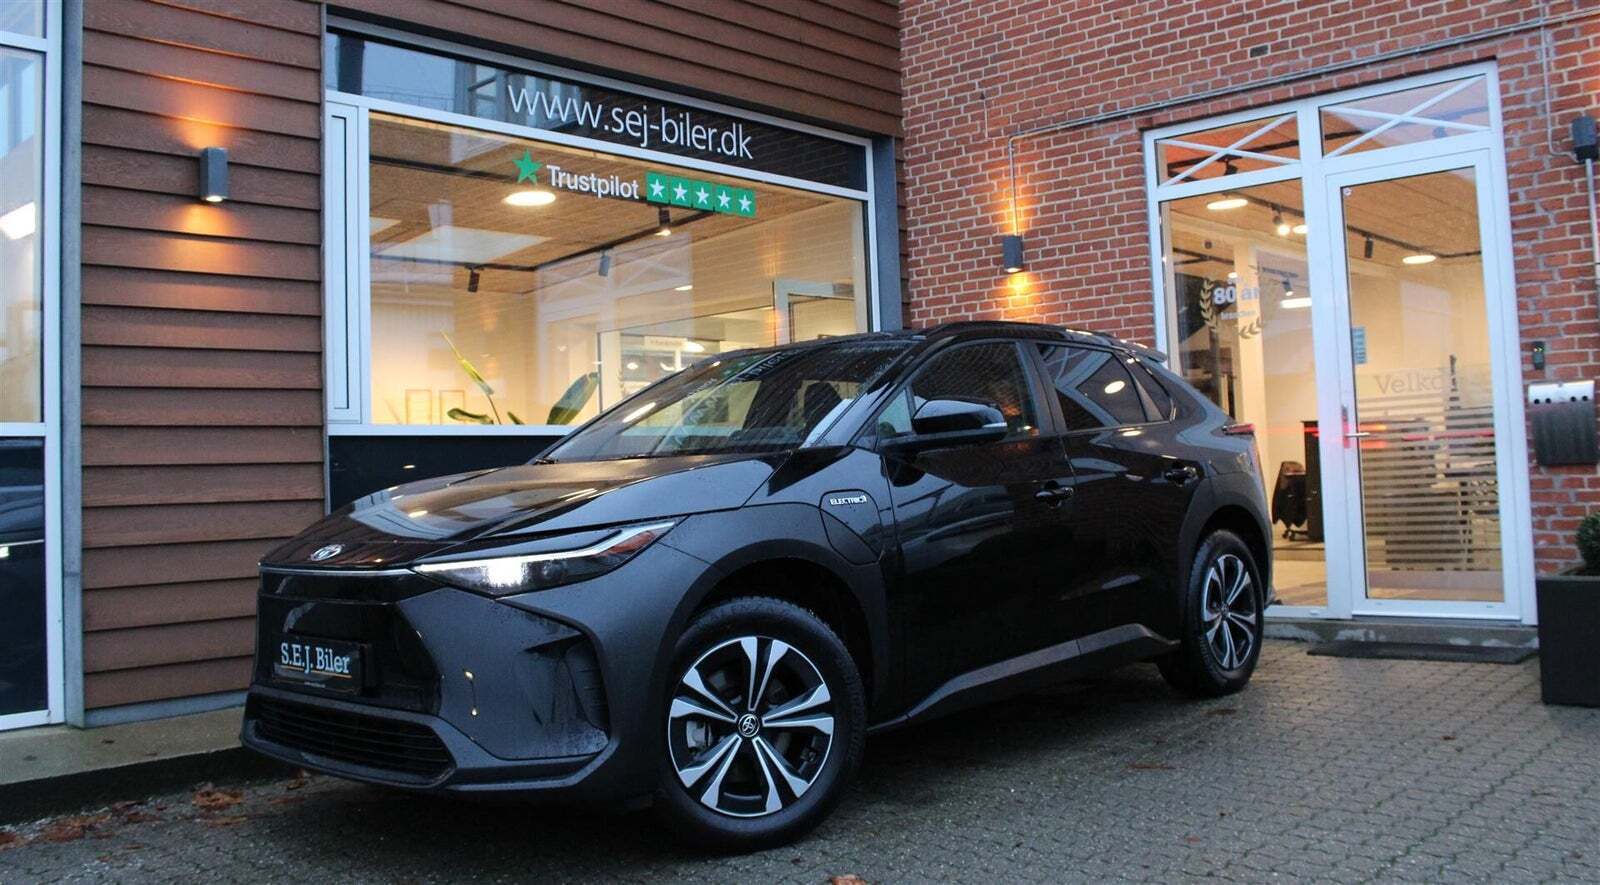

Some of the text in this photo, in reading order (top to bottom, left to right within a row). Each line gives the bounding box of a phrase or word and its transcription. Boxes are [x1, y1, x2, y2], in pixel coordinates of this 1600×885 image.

[508, 84, 753, 160] www.sej-biler.dk
[546, 164, 640, 200] Trustpilot
[1213, 286, 1237, 305] 80
[280, 642, 351, 674] S.E.J. Biler
